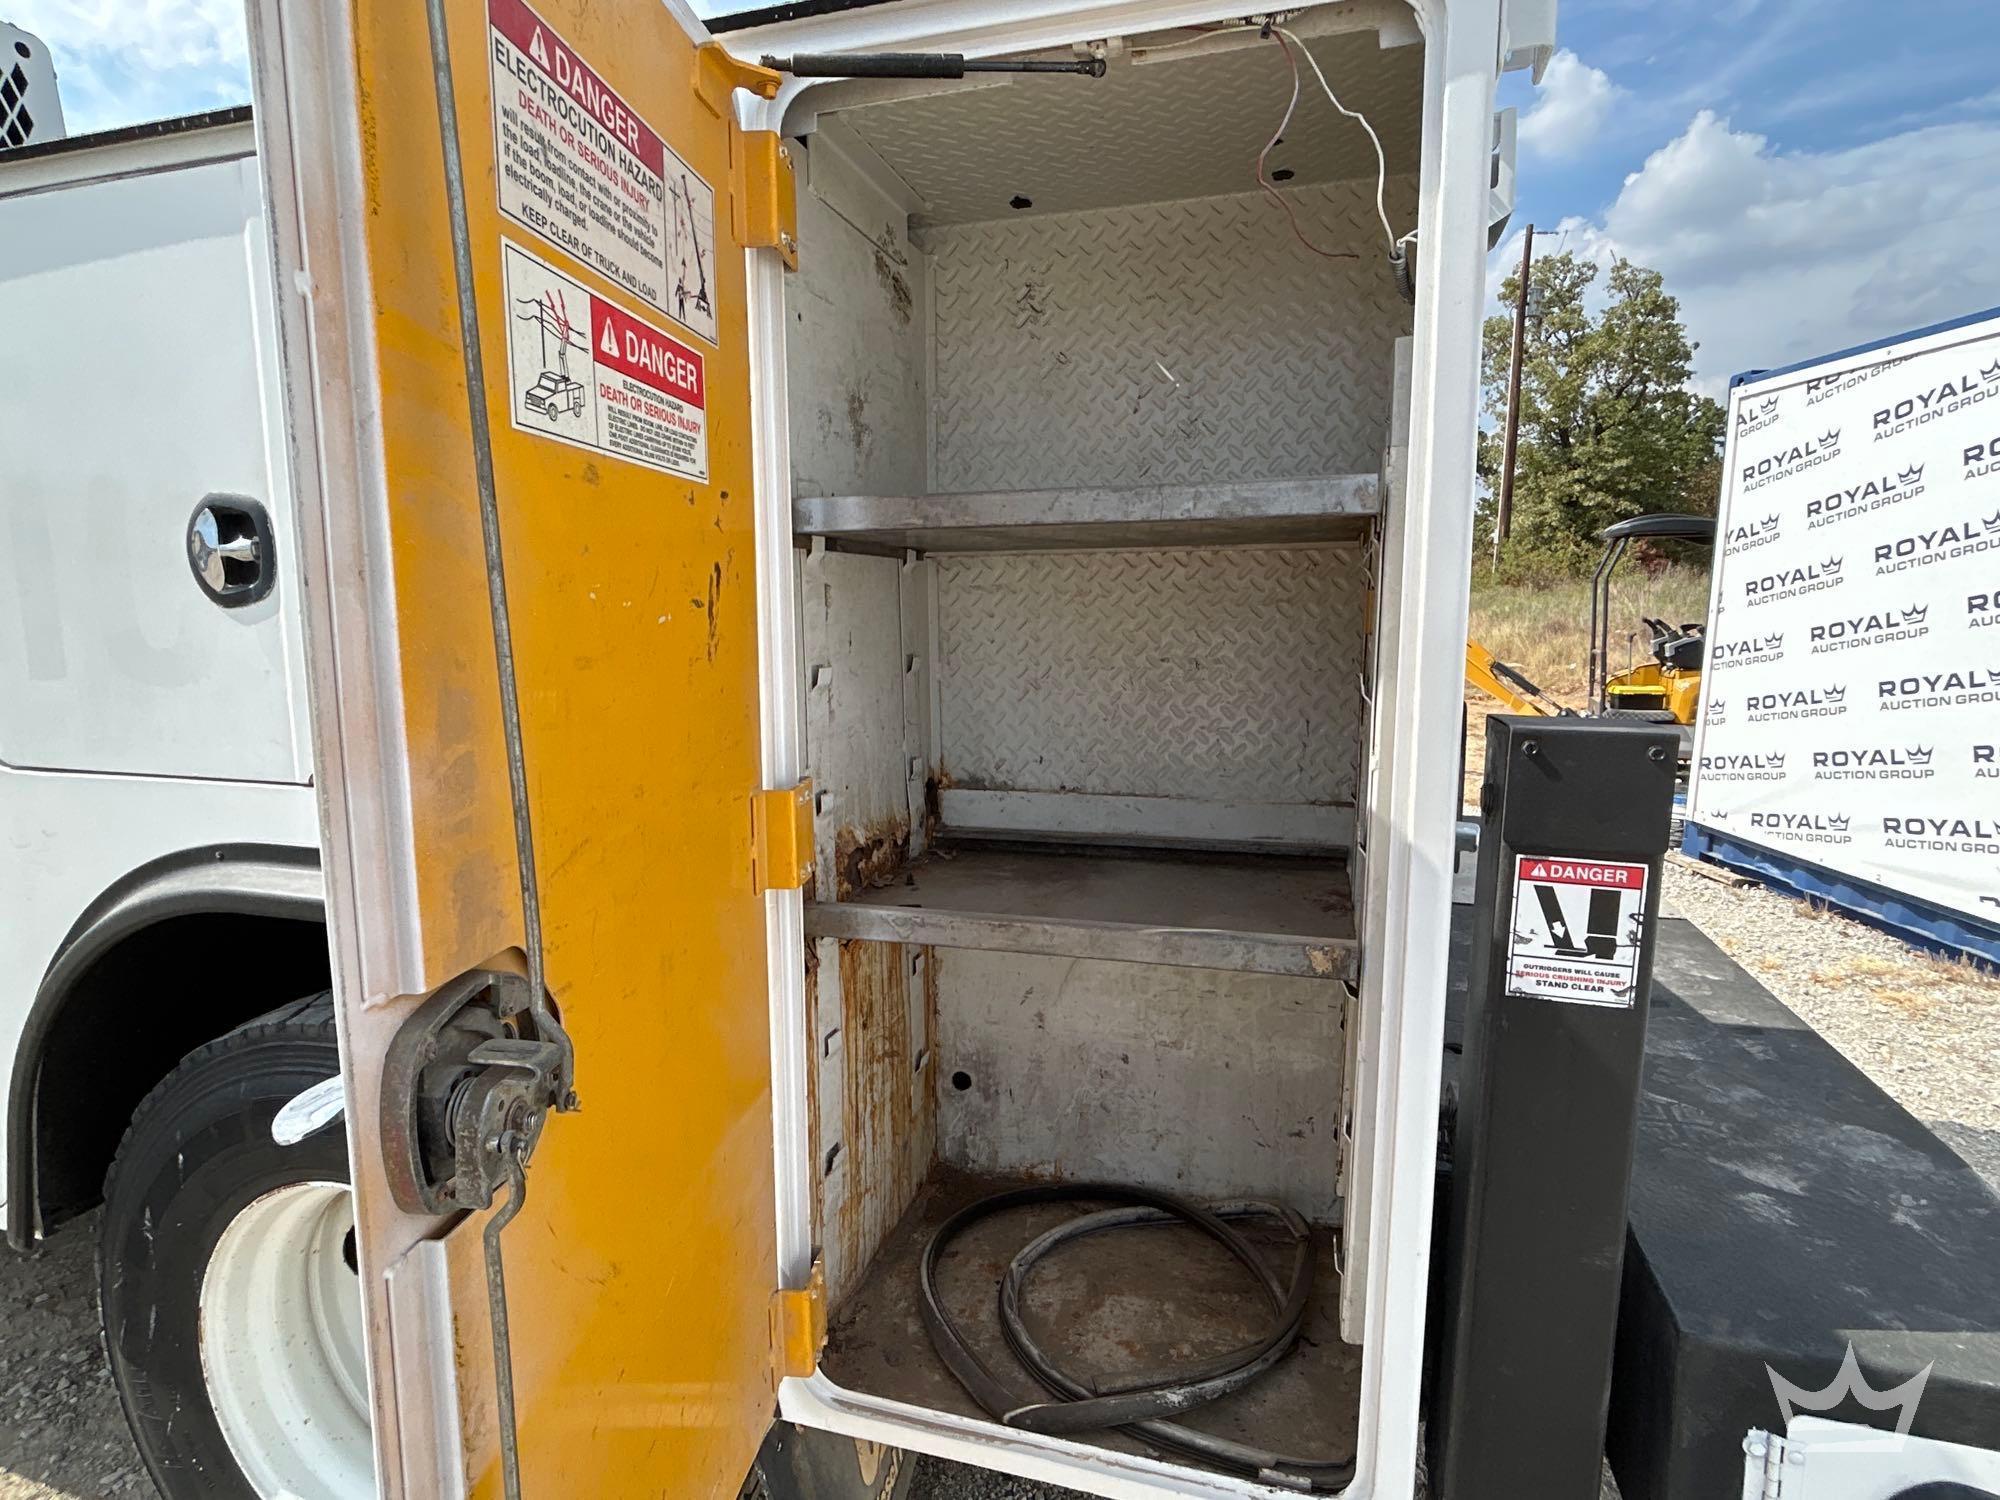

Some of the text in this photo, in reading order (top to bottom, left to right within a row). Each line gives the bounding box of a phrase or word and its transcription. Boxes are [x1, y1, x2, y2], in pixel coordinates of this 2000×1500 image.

[555, 45, 640, 155] DANGER
[495, 36, 663, 202] ELECTROCUTION HAZARD
[501, 105, 518, 127] will
[520, 121, 545, 147] result
[547, 139, 567, 165] from
[568, 160, 596, 189] contact
[598, 182, 612, 201] with
[614, 196, 620, 207] or
[519, 89, 649, 213] DEATH OR SERIOUS INJURY
[502, 123, 517, 144] the
[579, 182, 591, 201] the
[593, 195, 612, 217] crane
[504, 141, 511, 157] if
[512, 149, 527, 170] the
[579, 201, 587, 214] or
[505, 164, 589, 231] electrically charged.
[522, 202, 657, 301] KEEP CLEAR OF TRUCK AND LOAD
[625, 329, 697, 394] DANGER
[1806, 372, 1867, 407] AUCTION
[1873, 375, 1978, 429] ROYAL
[600, 383, 701, 434] DEATH OR SERIOUS INJURY
[1740, 414, 1779, 438] GROUP
[1874, 407, 1943, 442] AUCTION
[1743, 441, 1817, 482] ROYAL
[1744, 448, 1841, 493] AUCTION GROUP
[1807, 477, 1897, 518] ROYAL
[1808, 485, 1924, 530] AUCTION GROUP
[1741, 532, 1781, 551] GROUP
[1875, 522, 1980, 563] ROYAL
[1876, 551, 1946, 576] AUCTION
[1745, 565, 1820, 596] ROYAL
[1747, 576, 1844, 608] AUCTION GROUP
[1811, 612, 1900, 642] ROYAL
[1811, 627, 1929, 655] AUCTION GROUP
[1745, 652, 1784, 665] GROUP
[1879, 671, 1986, 697] ROYAL
[1747, 690, 1823, 711] ROYAL
[1748, 706, 1847, 722] AUCTION GROUP
[1880, 696, 1951, 711] AUCTION
[1700, 755, 1765, 770] ROYAL
[1813, 749, 1905, 767] ROYAL
[1700, 772, 1787, 781] AUCTION GROUP
[1815, 769, 1934, 780] AUCTION GROUP
[1751, 812, 1827, 830] ROYAL
[1883, 817, 1992, 839] ROYAL
[1806, 833, 1852, 844] GROUP
[1885, 838, 1957, 852] AUCTION
[1550, 864, 1628, 884] DANGER
[1516, 969, 1627, 987] SERIOUS CRUSHING INJURY
[1523, 963, 1620, 979] OUTRIGGERS WILL CAUSE
[1535, 979, 1605, 993] STAND CLEAR
